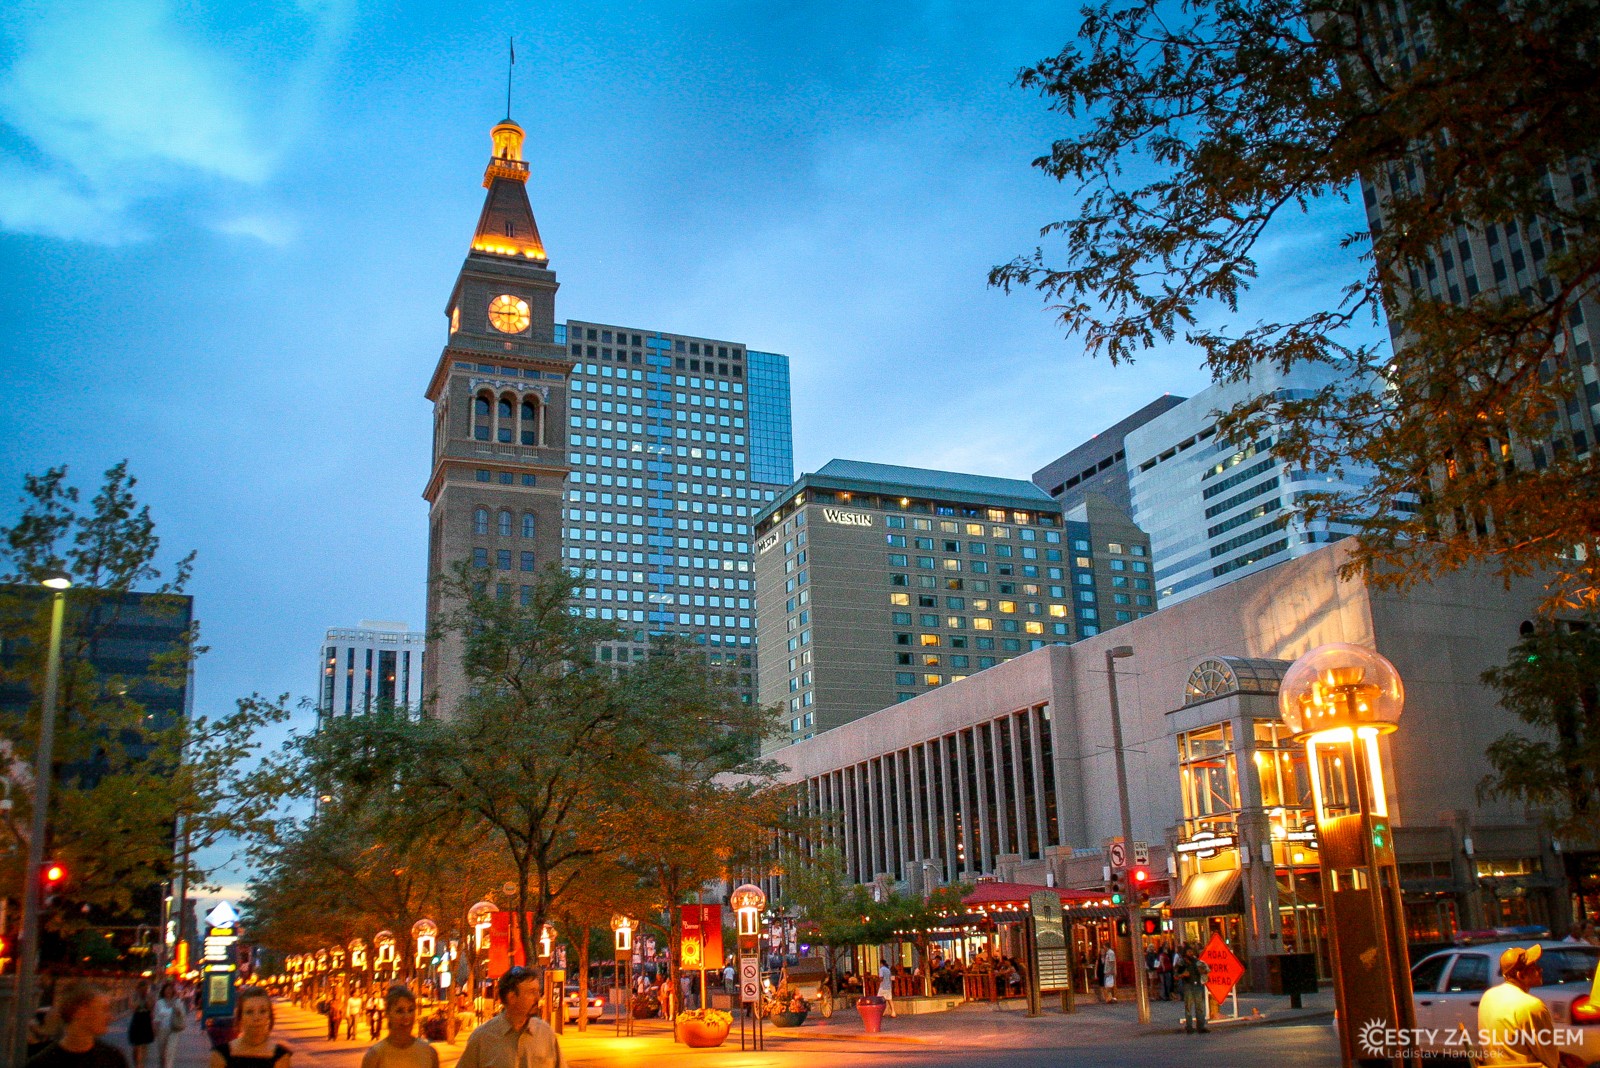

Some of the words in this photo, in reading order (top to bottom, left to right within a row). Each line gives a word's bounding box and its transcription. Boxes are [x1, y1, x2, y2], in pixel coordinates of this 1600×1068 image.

[823, 508, 873, 527] WESTIN
[1135, 842, 1147, 850] ONE
[1207, 951, 1227, 960] ROAD
[1207, 976, 1231, 986] AHEAD
